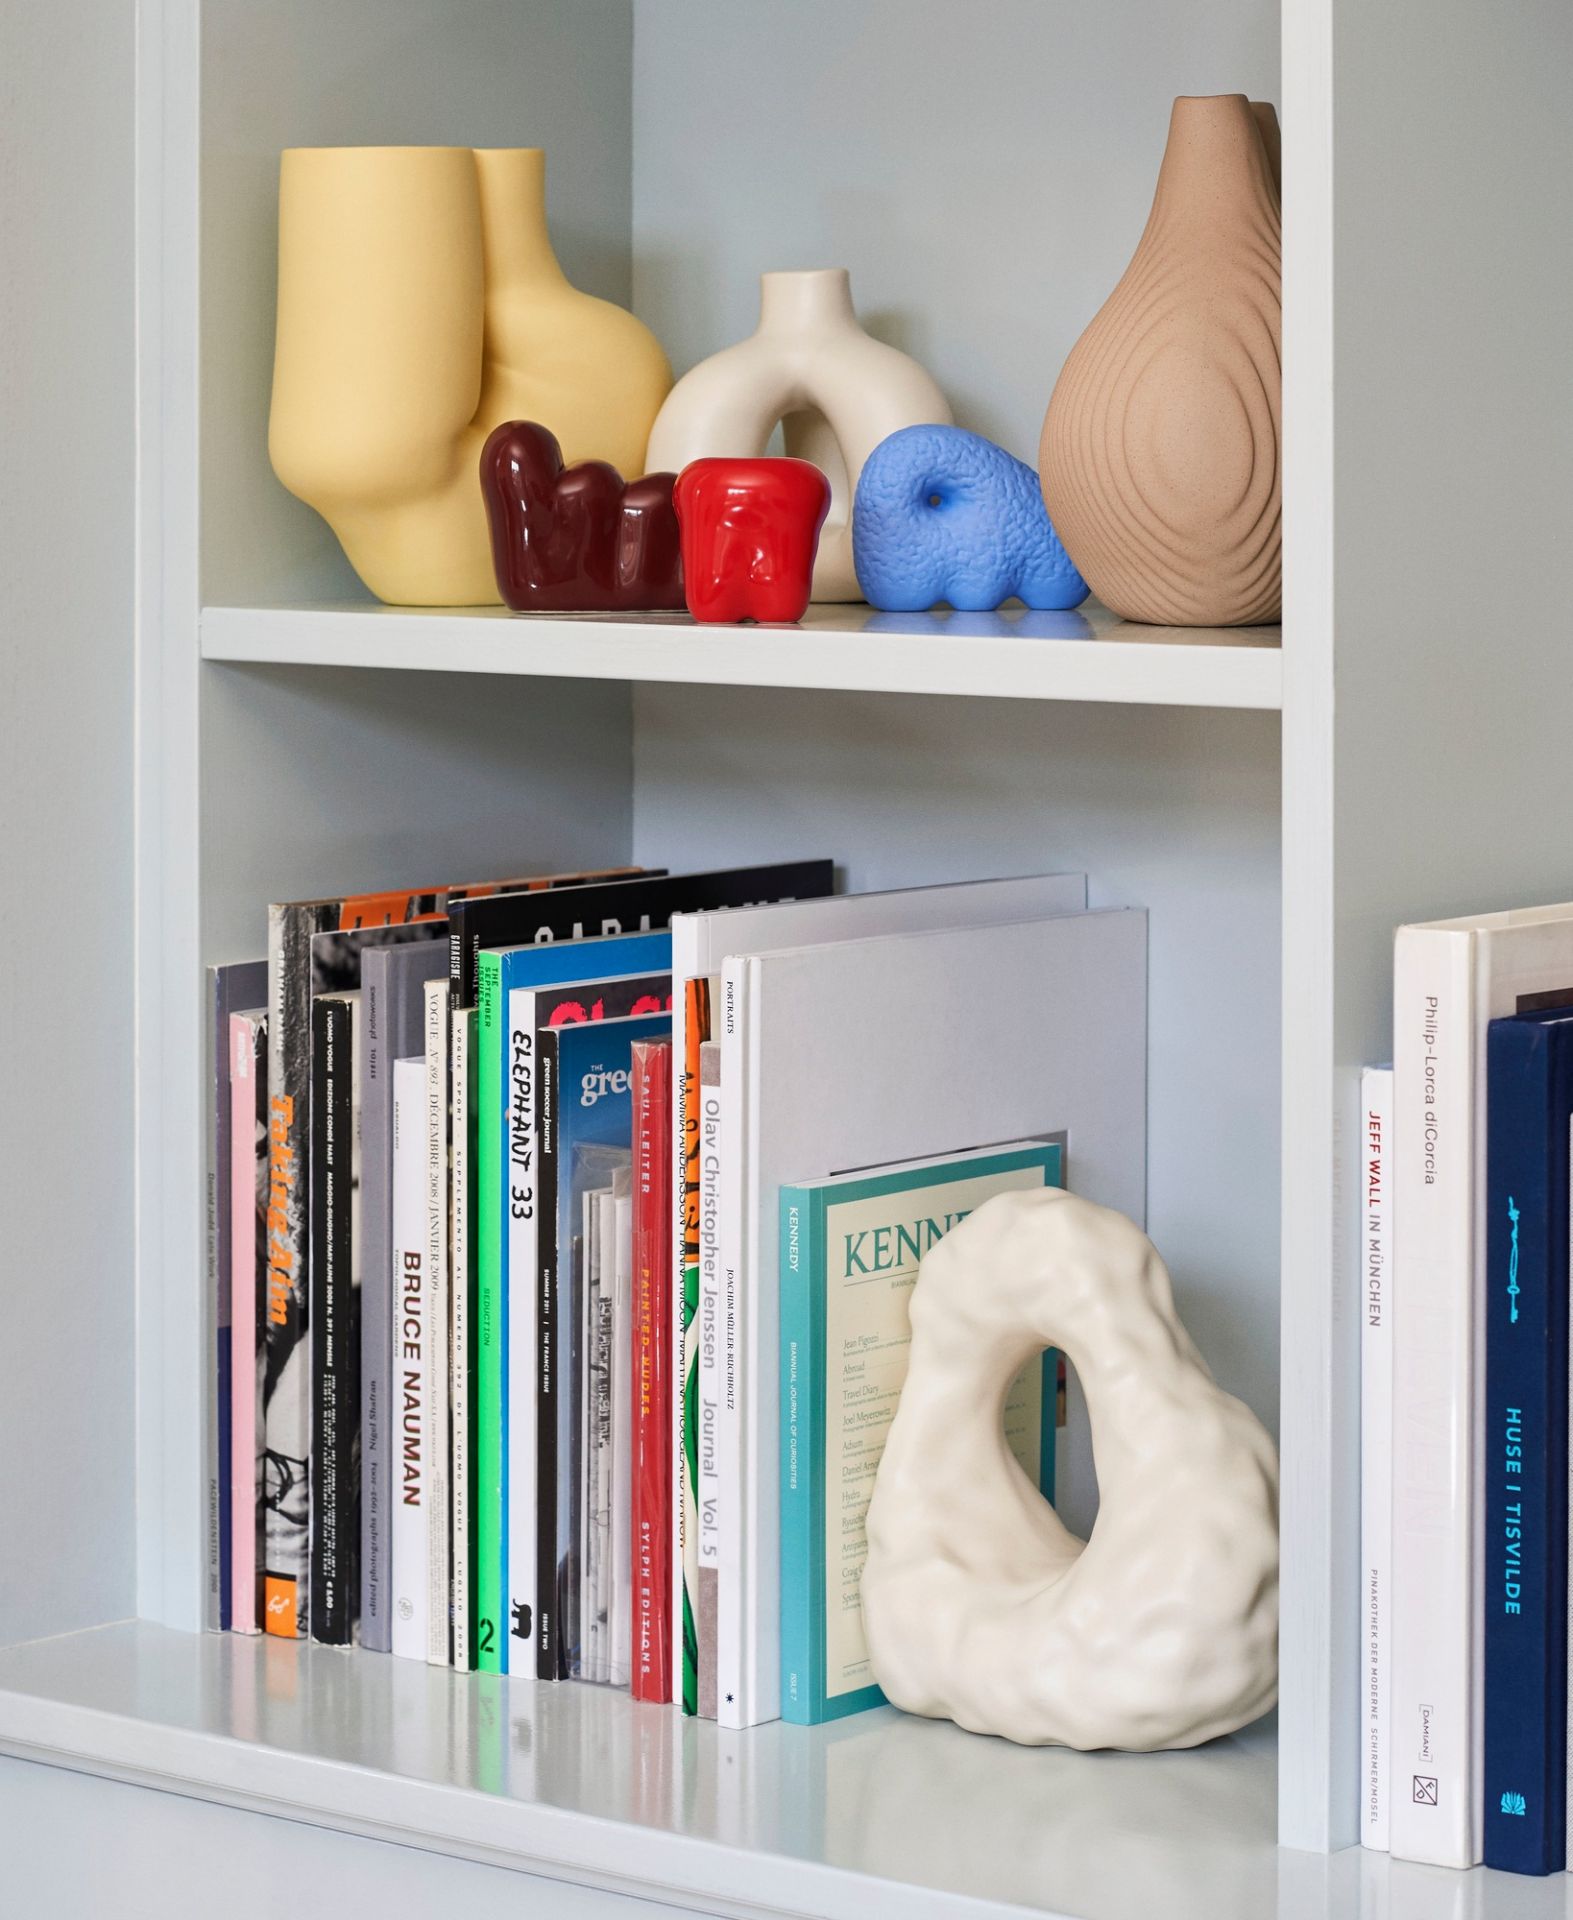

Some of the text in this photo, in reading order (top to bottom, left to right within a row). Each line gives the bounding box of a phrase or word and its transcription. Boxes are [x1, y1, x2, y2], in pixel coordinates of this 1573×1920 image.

[450, 935, 460, 980] GARAGISME
[368, 986, 377, 1039] photoworks
[429, 993, 438, 1040] VOGUE
[726, 980, 734, 1034] PORTRAITS
[543, 1057, 552, 1085] green
[1422, 996, 1439, 1185] Philip-Lorca diCorcia
[326, 1115, 335, 1142] CONDÉ
[429, 1094, 441, 1170] DÉCEMBRE
[512, 1030, 533, 1220] ELEPHANT 33
[543, 1118, 552, 1154] journal
[429, 1172, 438, 1198] 2008
[642, 1130, 650, 1194] LEITER
[267, 1095, 294, 1326] Taking Aim
[428, 1206, 439, 1262] JANVIER
[700, 1099, 720, 1369] Olav Christopher Jenssen
[1369, 1110, 1384, 1327] JEFF WALL IN MÜNCHEN
[789, 1206, 799, 1272] KENNEDY
[844, 1210, 973, 1278] KENN
[430, 1264, 438, 1290] 2009
[457, 1266, 462, 1280] AL
[326, 1306, 334, 1316] N.
[641, 1268, 650, 1416] PAINTED NUDES
[726, 1268, 736, 1410] JOACHIM MÜLLER-RUCHHOLTZ
[369, 1380, 377, 1420] Shafran
[404, 1251, 421, 1506] BRUCE NAUMAN
[842, 1388, 861, 1400] Travel
[863, 1384, 879, 1396] Diary
[369, 1422, 377, 1450] Nigel
[790, 1425, 797, 1436] OF
[843, 1414, 856, 1426] Joel
[1506, 1408, 1521, 1474] HUSE
[703, 1398, 718, 1556] Journal Vol. 5
[369, 1518, 377, 1581] photographs
[1505, 1503, 1521, 1614] TISVILDE
[369, 1584, 377, 1616] edited
[641, 1522, 650, 1674] SYLPH EDITIONS
[480, 1618, 494, 1654] 2
